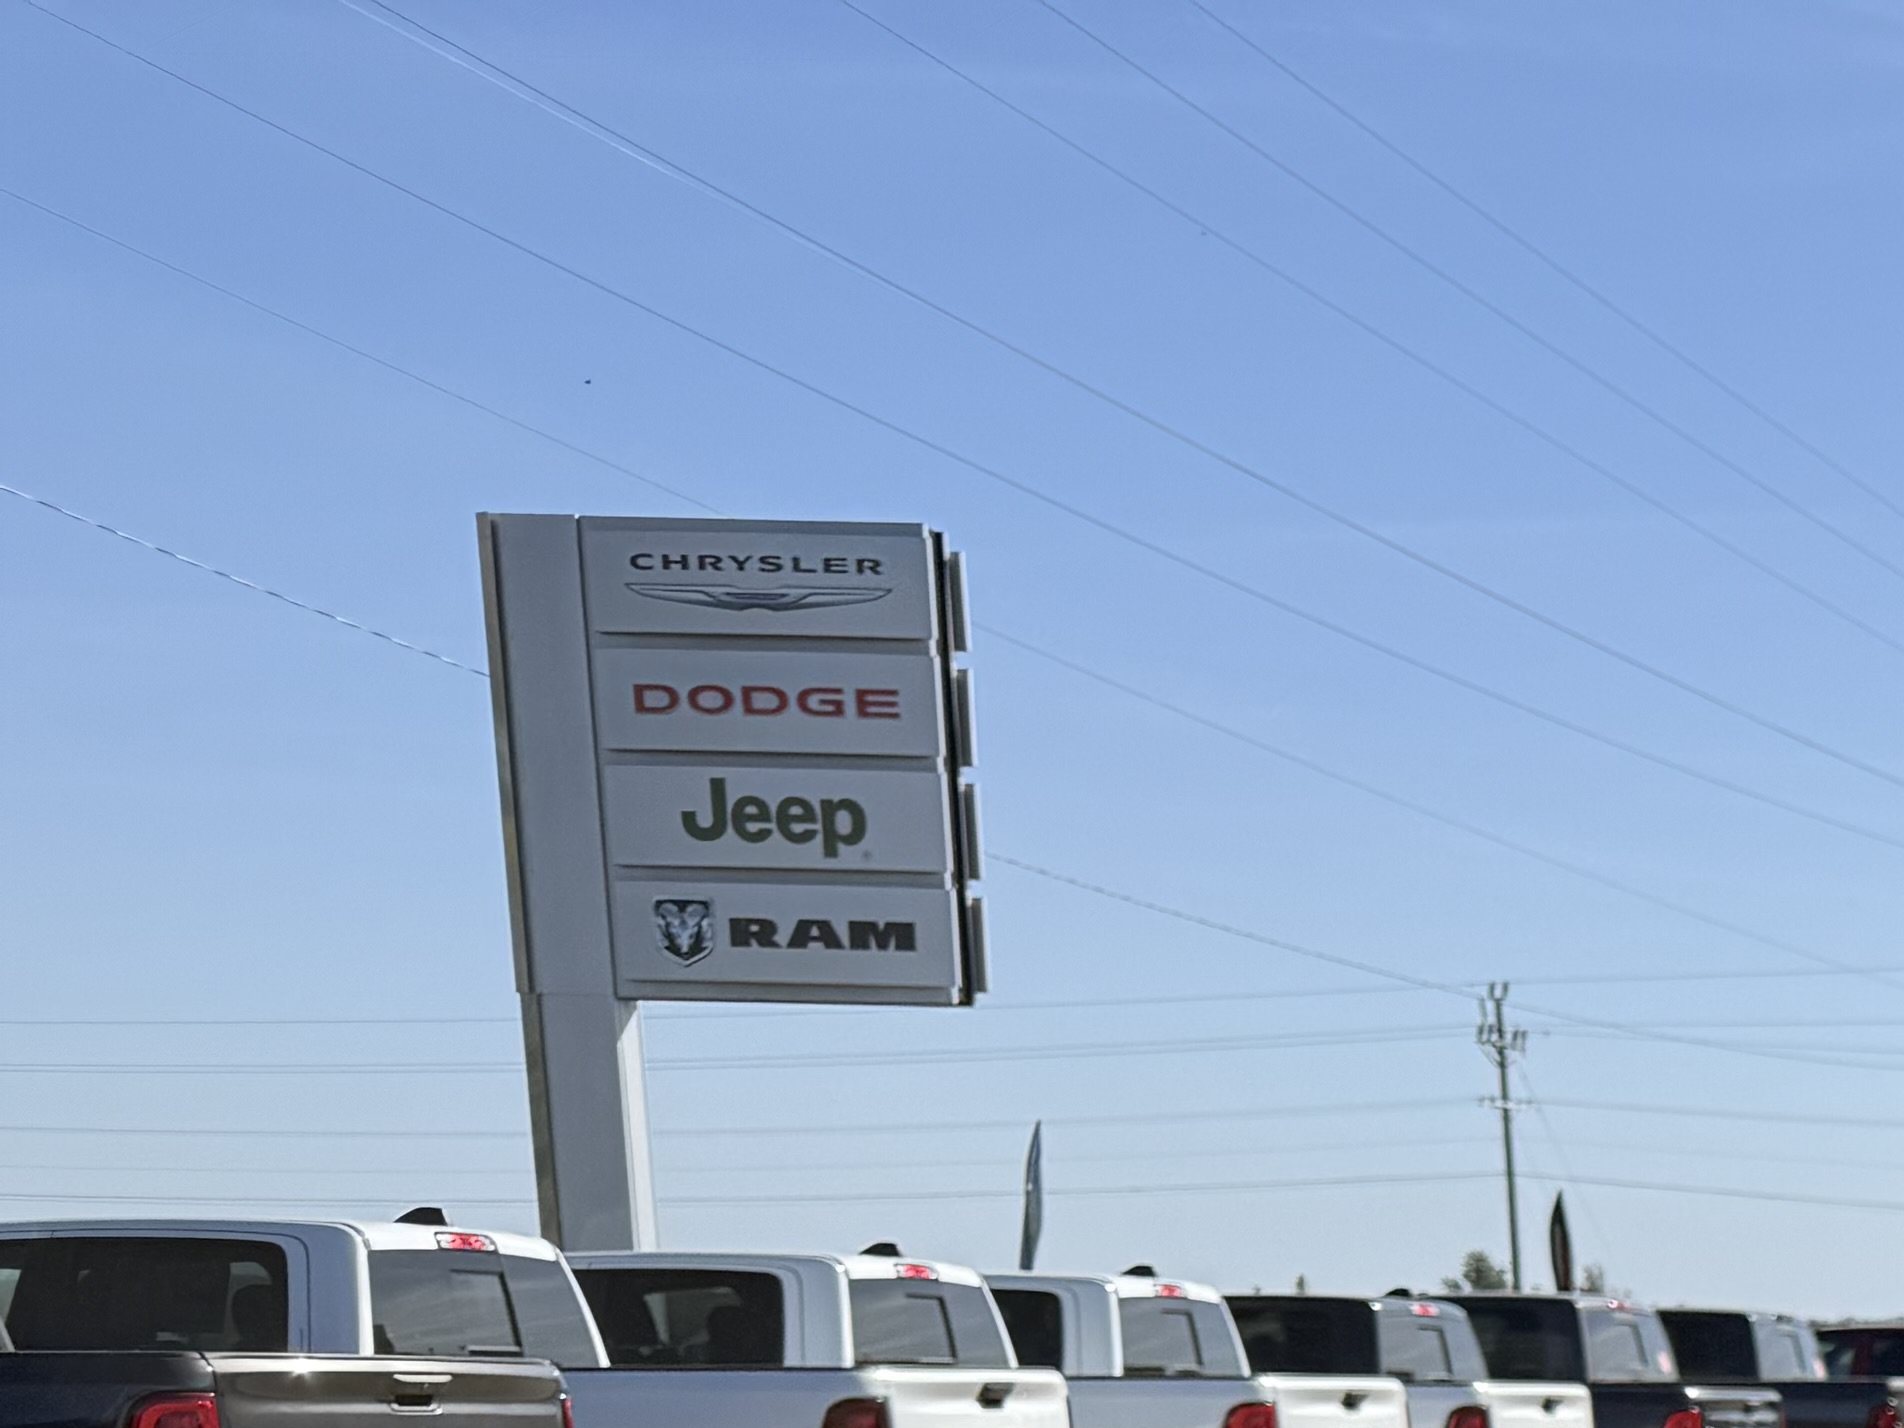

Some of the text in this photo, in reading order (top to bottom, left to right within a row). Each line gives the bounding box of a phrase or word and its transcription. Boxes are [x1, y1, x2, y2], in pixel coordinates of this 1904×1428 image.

[629, 552, 884, 576] CHRYSLER
[632, 683, 901, 719] DODGE
[681, 777, 867, 858] Jeep
[729, 918, 917, 952] RAM
